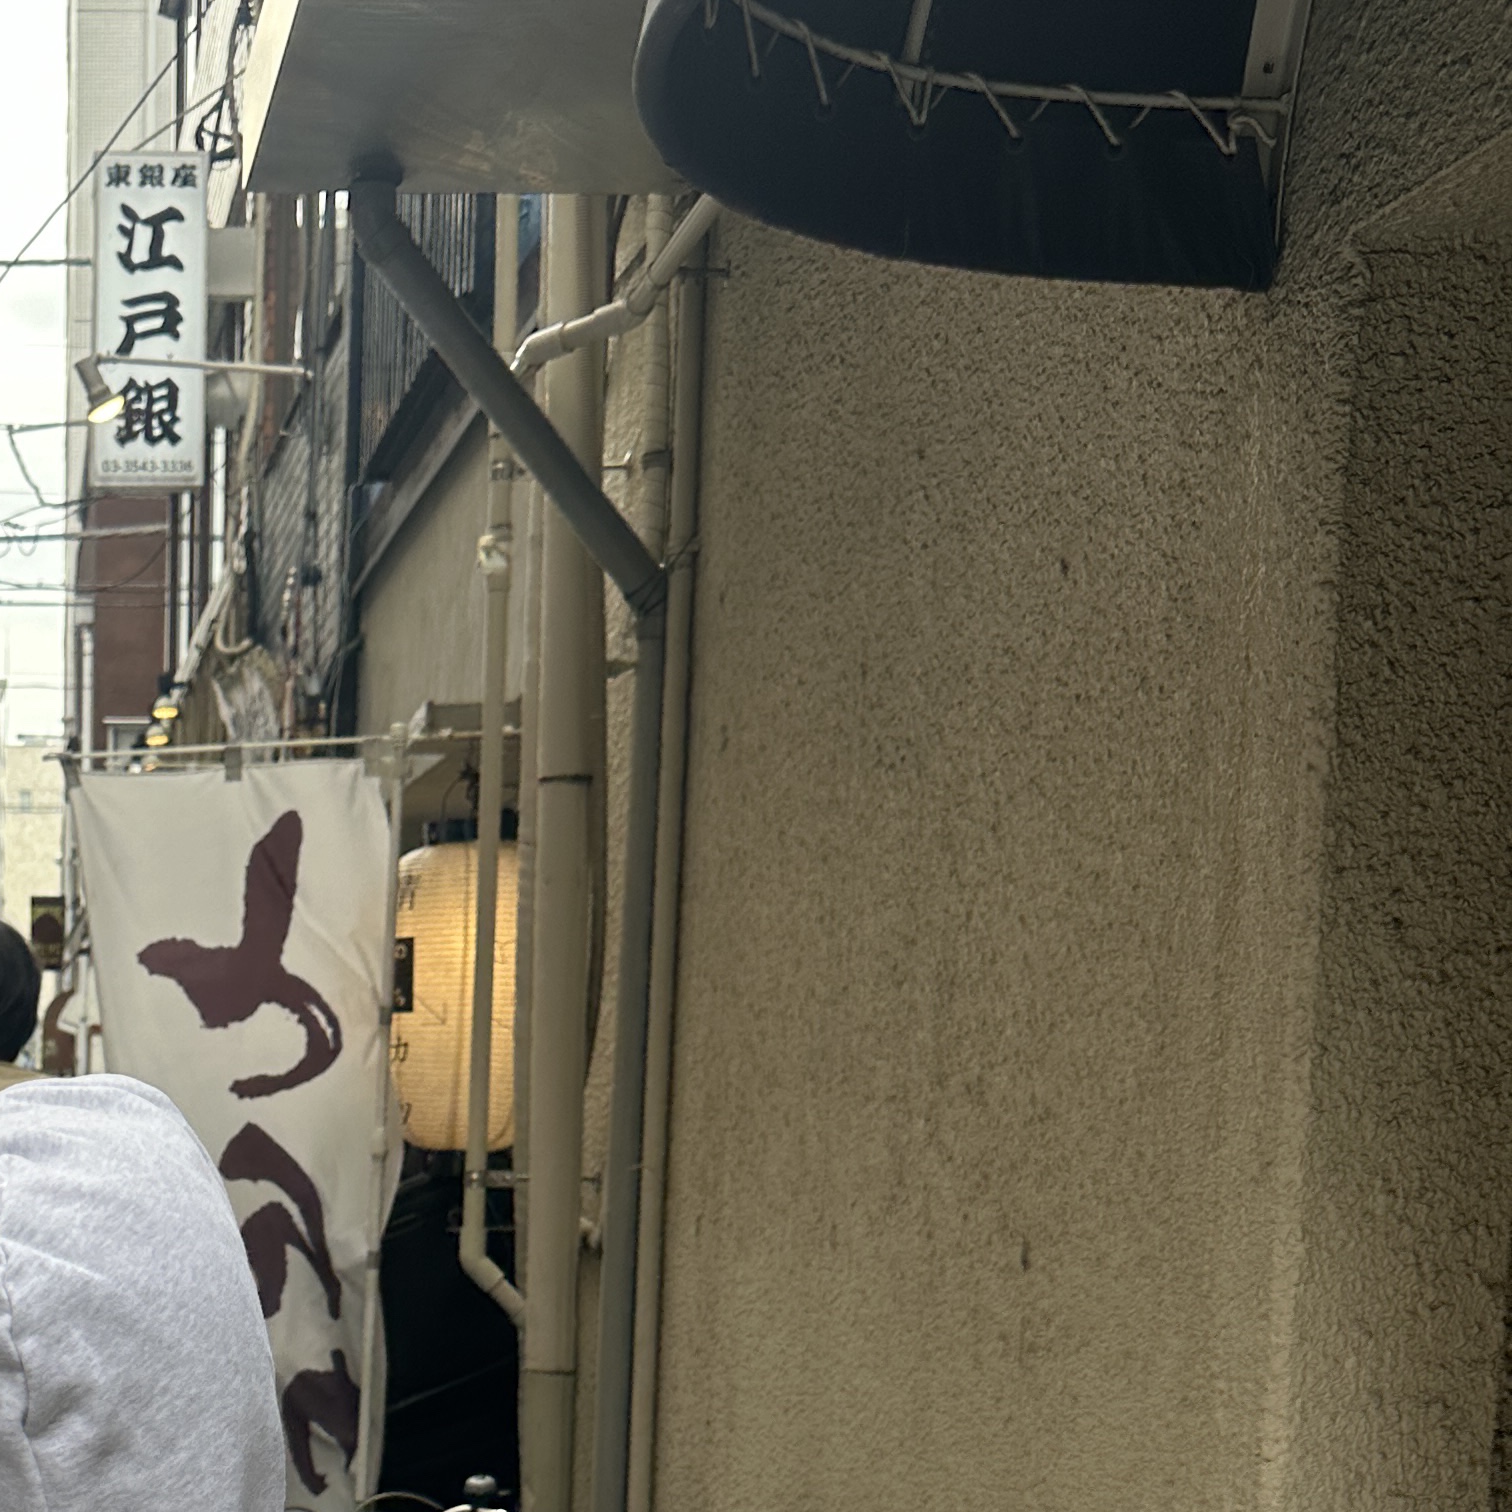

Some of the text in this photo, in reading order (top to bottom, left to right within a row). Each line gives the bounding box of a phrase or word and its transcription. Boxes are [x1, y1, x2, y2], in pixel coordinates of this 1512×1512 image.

[105, 163, 198, 188] 東銀座
[116, 202, 186, 448] 江戸銀
